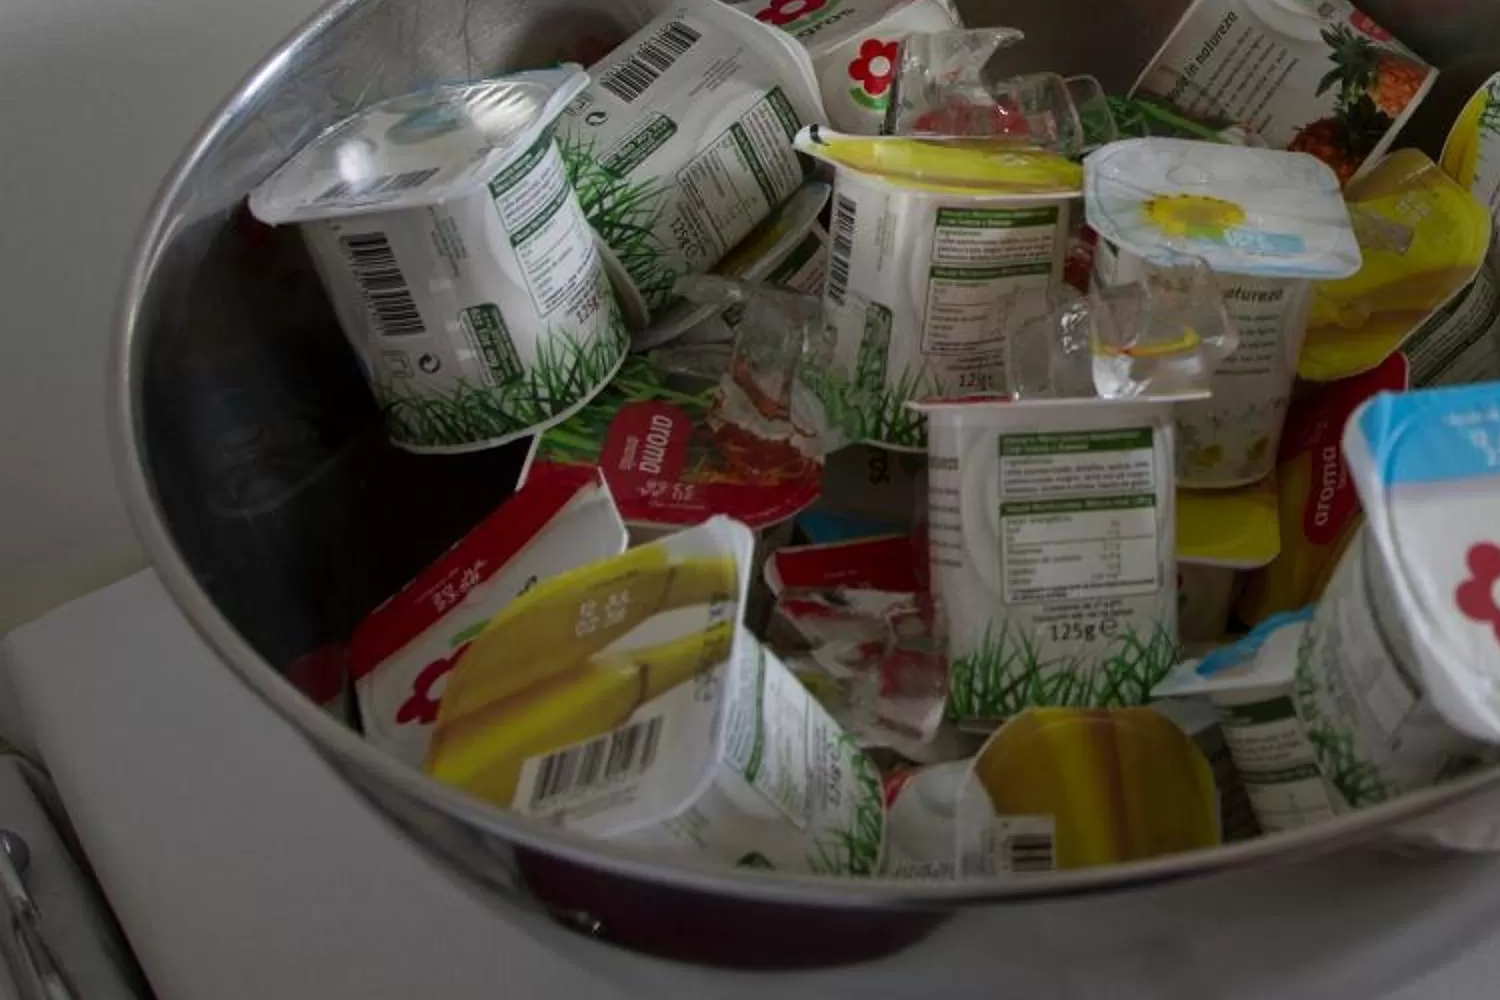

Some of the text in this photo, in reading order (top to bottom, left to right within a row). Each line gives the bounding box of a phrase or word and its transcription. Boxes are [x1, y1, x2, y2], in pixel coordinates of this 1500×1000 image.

[639, 414, 674, 474] aroma
[1314, 446, 1337, 527] aroma
[1050, 622, 1095, 643] 125g
